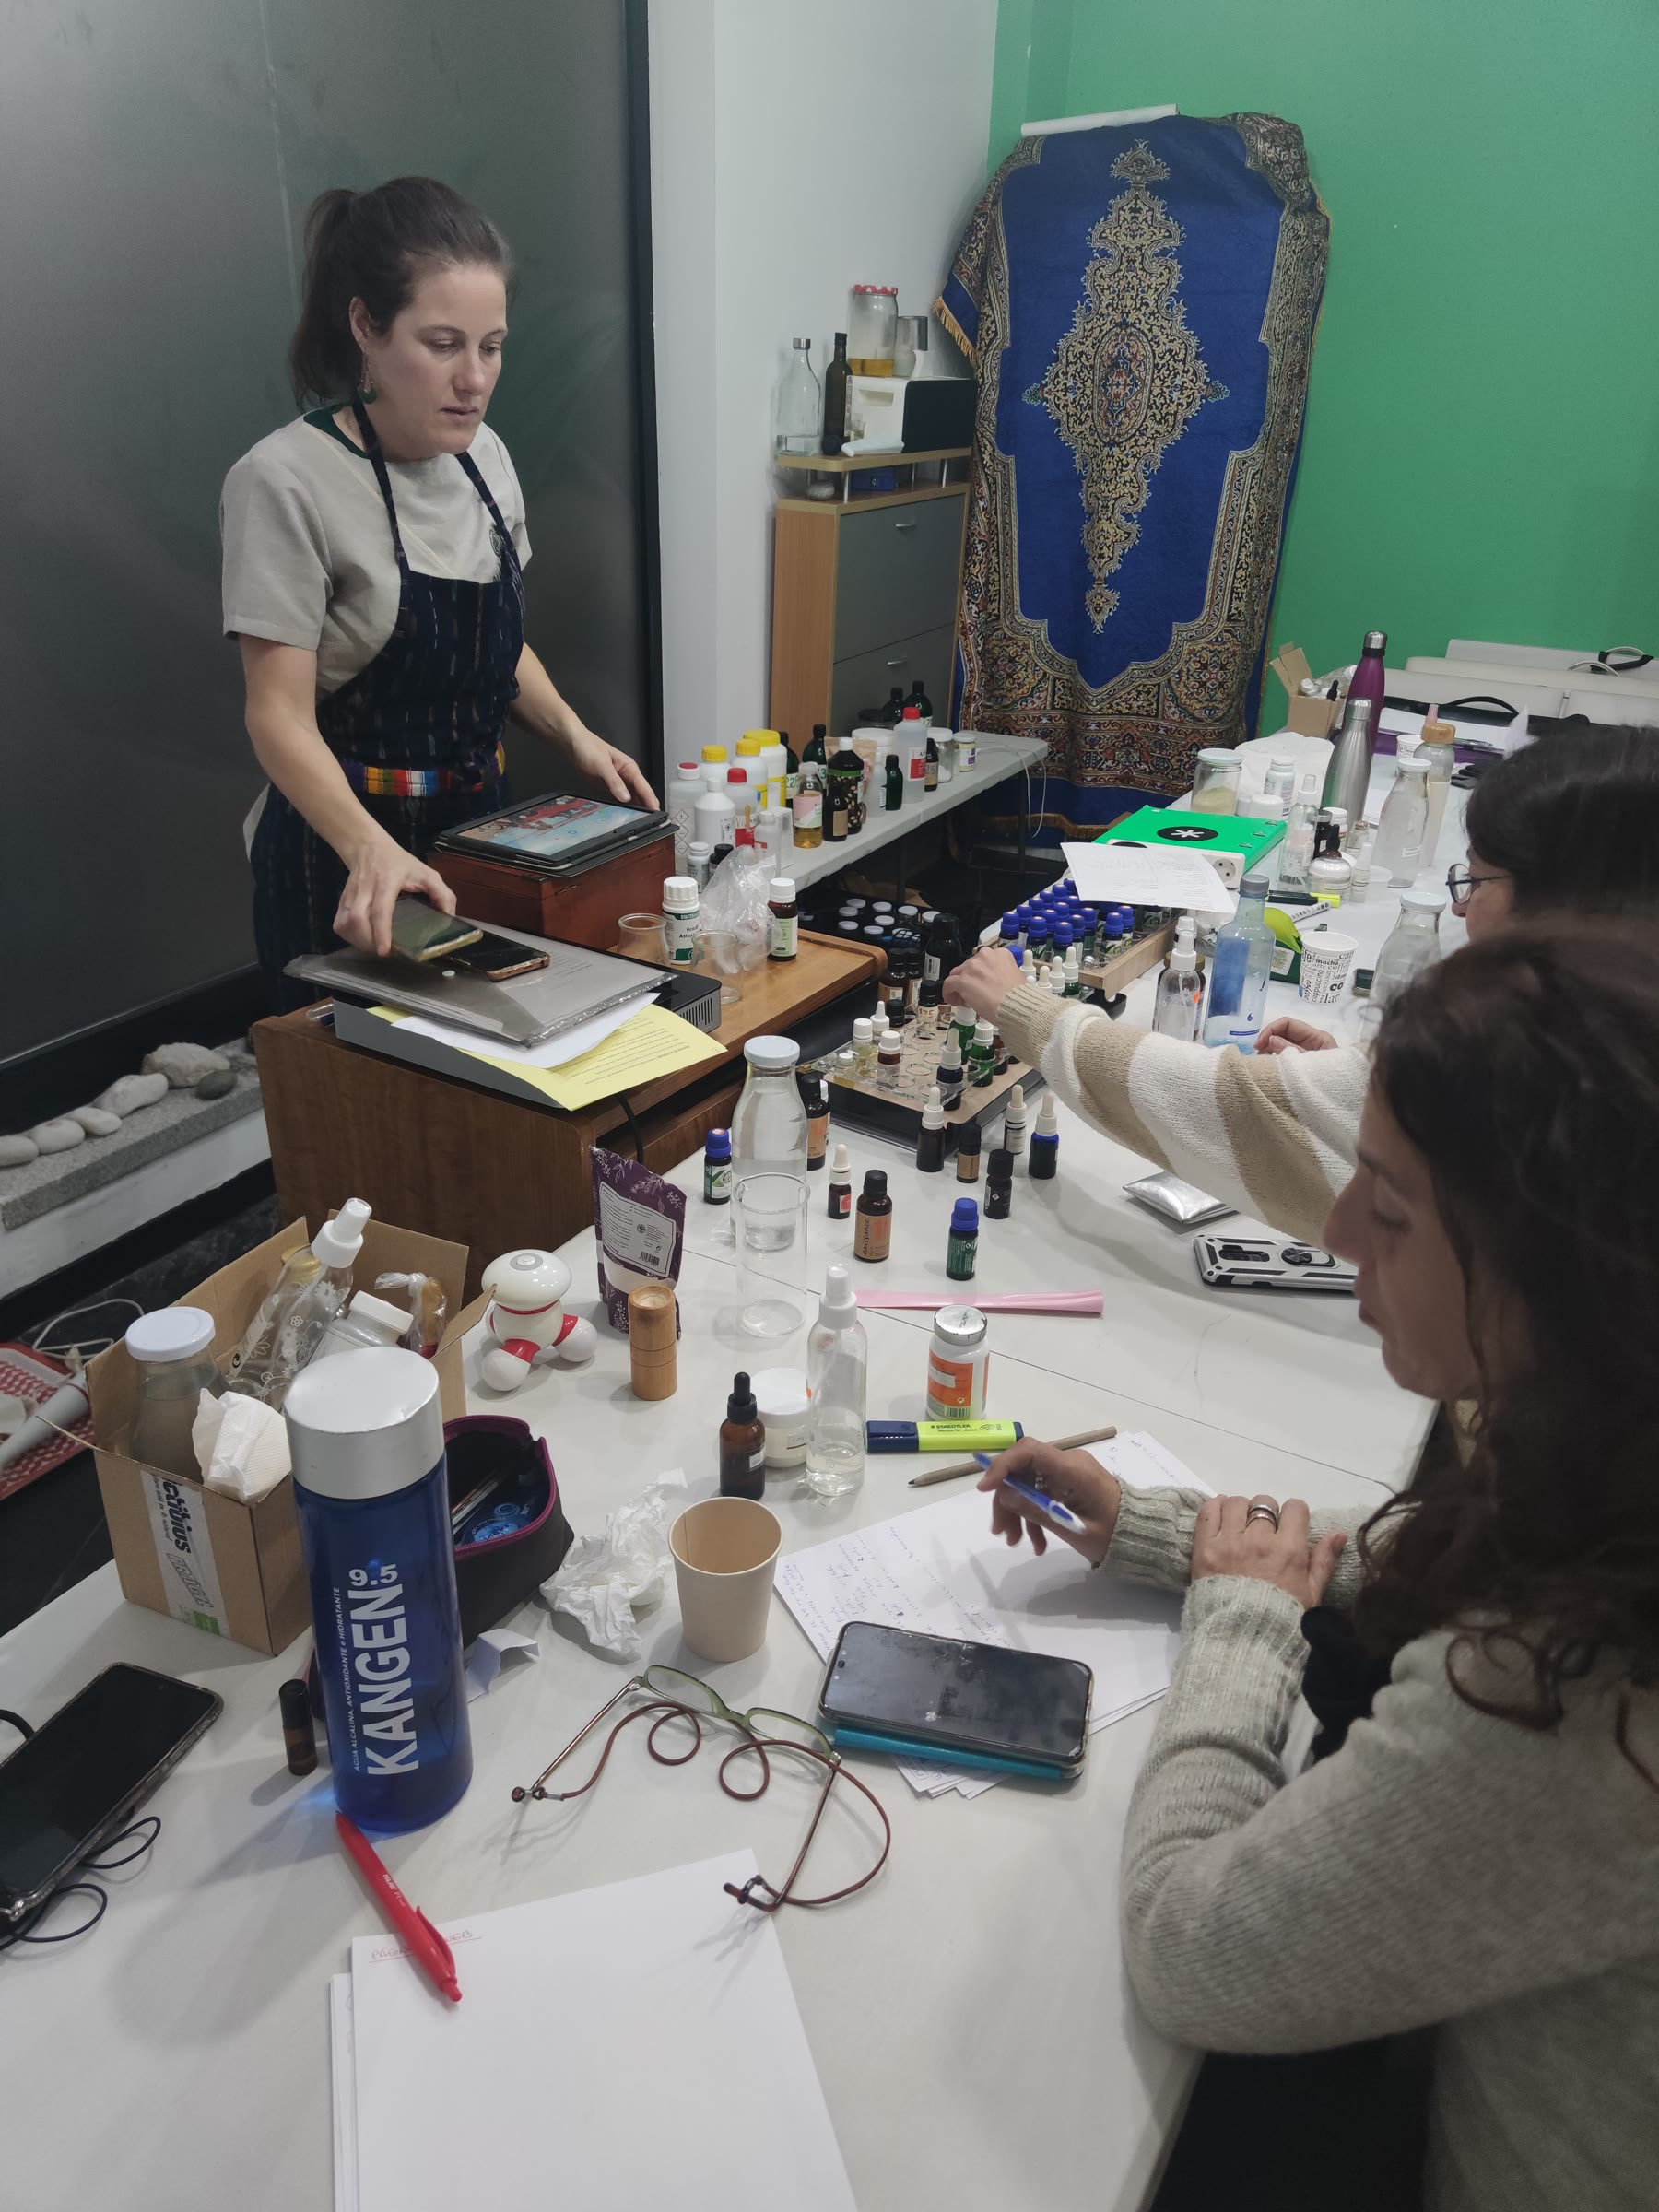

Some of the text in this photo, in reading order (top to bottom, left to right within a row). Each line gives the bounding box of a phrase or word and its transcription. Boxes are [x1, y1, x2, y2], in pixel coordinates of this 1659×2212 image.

[1312, 969, 1324, 1003] cappuccino
[347, 1563, 399, 1587] 9.5
[333, 1586, 346, 1641] HIDRATANTE
[340, 1646, 353, 1707] ANTIOXIDANTE
[347, 1583, 419, 1775] KANGEN
[349, 1749, 360, 1772] AGUA
